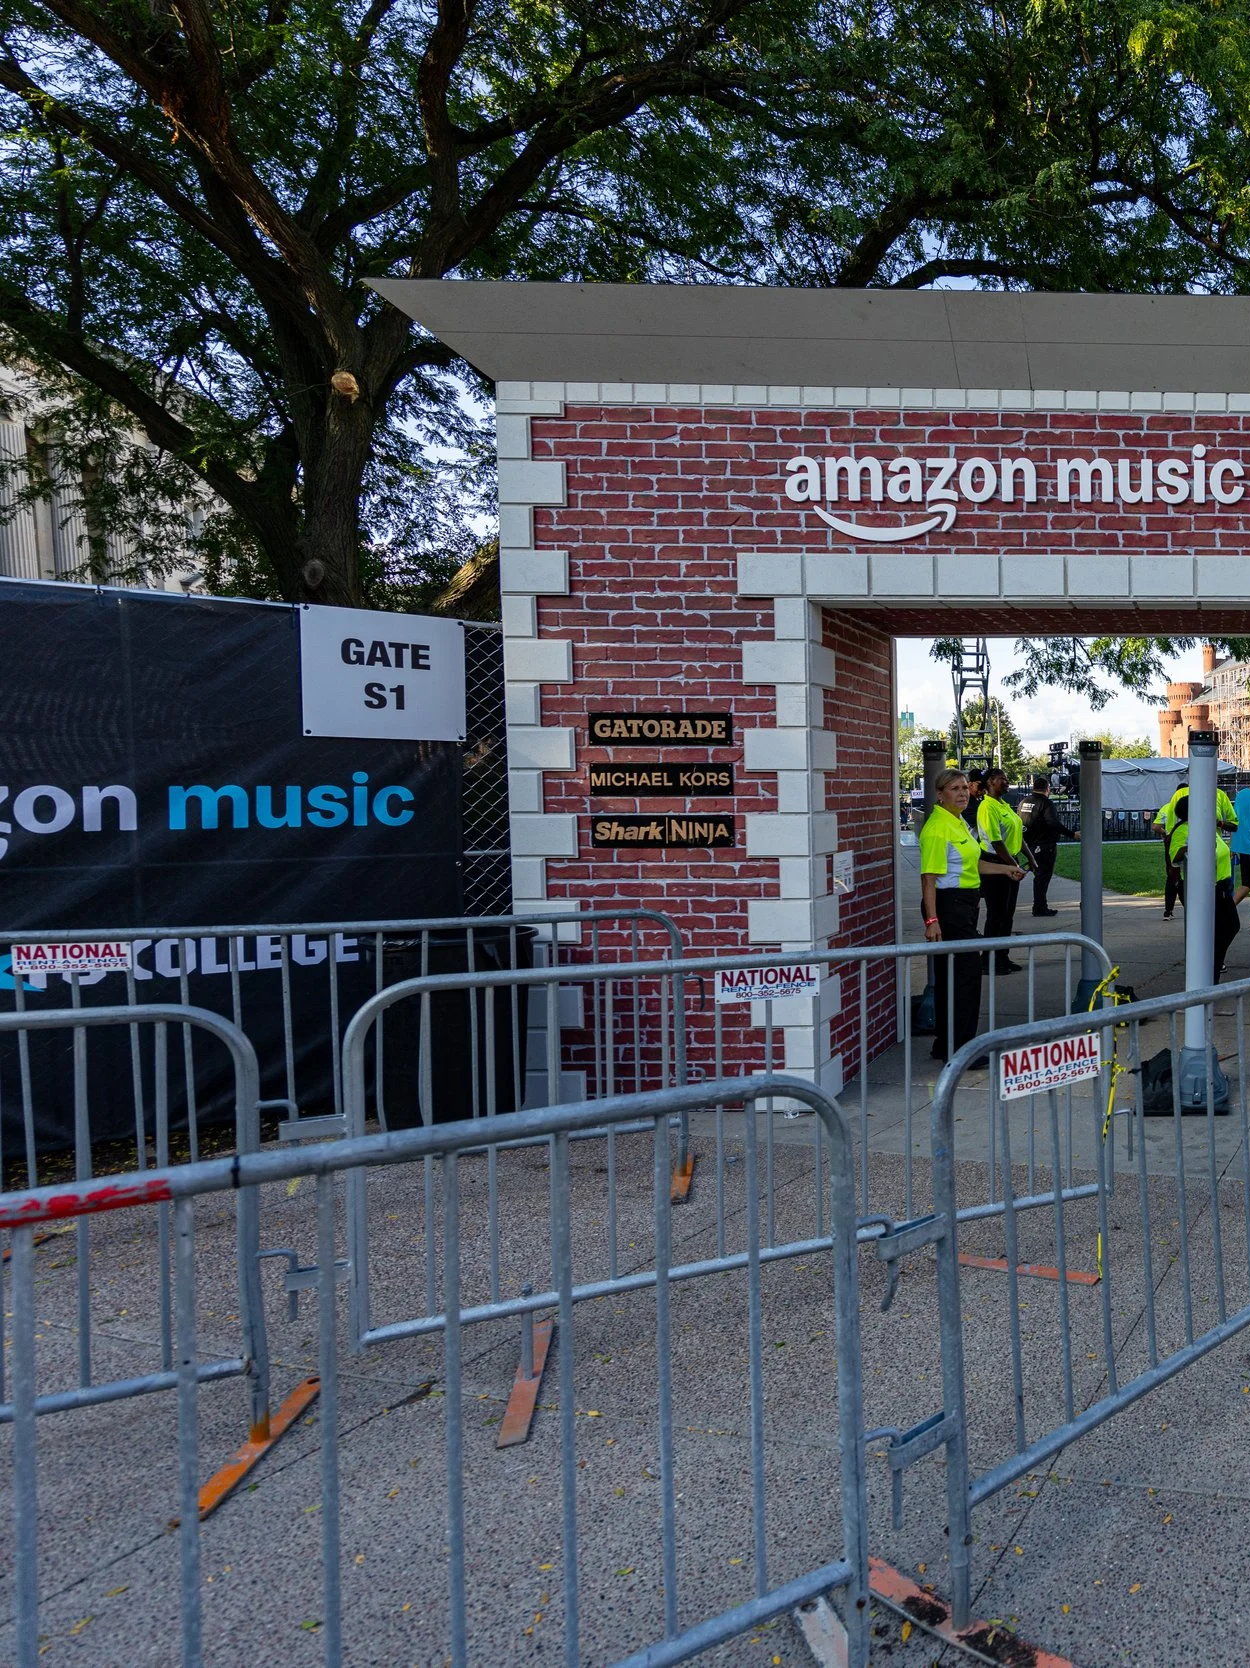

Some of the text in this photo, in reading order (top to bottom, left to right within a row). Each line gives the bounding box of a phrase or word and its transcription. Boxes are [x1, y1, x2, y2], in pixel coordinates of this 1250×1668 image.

[784, 443, 1246, 505] amazon music
[340, 637, 432, 672] GATE
[362, 681, 406, 712] S1
[593, 719, 726, 739] GATORADE
[591, 772, 731, 787] MICHAEL KORS
[167, 771, 416, 831] music
[594, 821, 664, 841] Shark
[16, 943, 128, 961] NATIONAL
[16, 958, 128, 966] RENT-A-FENCE
[131, 932, 360, 982] COLLEGE
[17, 962, 129, 971] 1-800-352-5675
[721, 965, 817, 988] NATIONAL
[721, 981, 815, 994] RENT-A-FENCE
[735, 987, 802, 999] 800-352-5675
[1004, 1035, 1098, 1078] NATIONAL
[1004, 1057, 1098, 1087] RENT-A-FENCE
[1004, 1064, 1099, 1095] 1-800-352-5675
